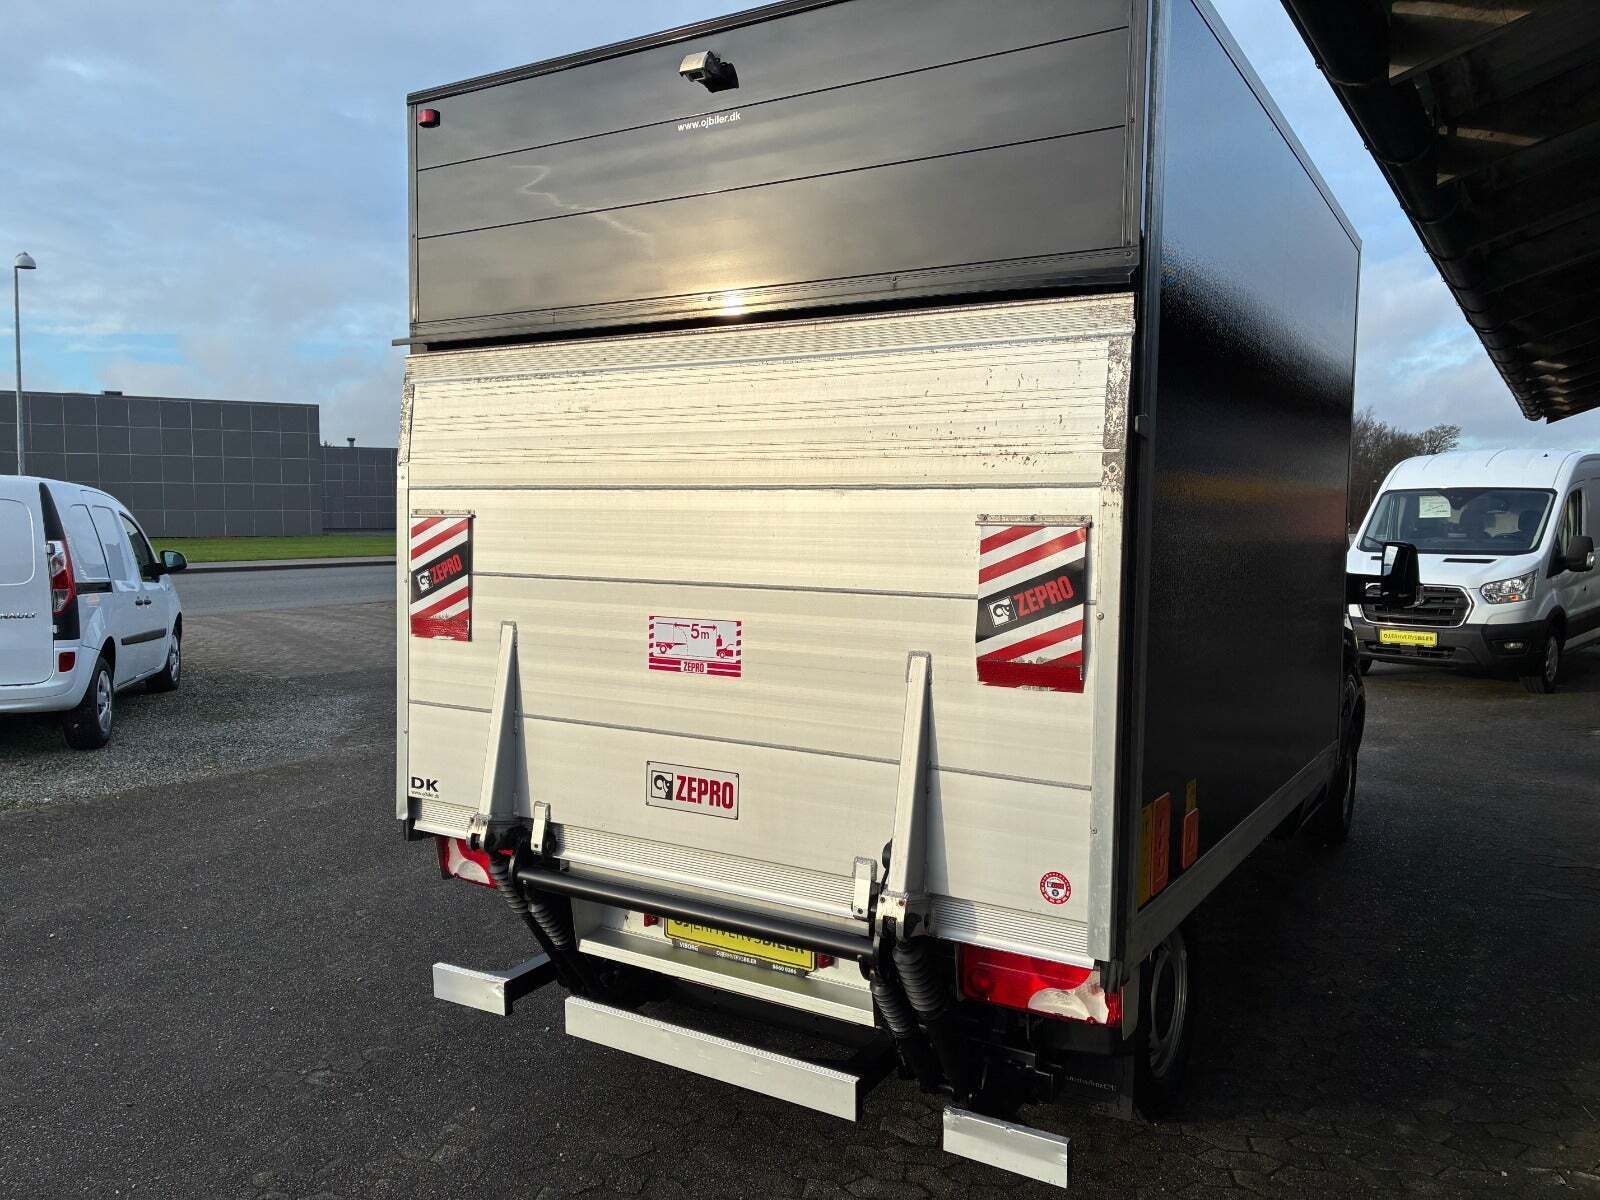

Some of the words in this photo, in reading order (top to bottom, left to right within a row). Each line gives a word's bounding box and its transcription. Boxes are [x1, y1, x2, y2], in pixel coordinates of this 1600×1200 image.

[677, 111, 741, 132] www.ojbiler.dk
[431, 554, 463, 585] ZEPRO
[1013, 575, 1074, 618] ZEPRO
[683, 661, 705, 673] ZEPRO
[411, 776, 439, 792] DK
[675, 774, 734, 810] ZEPRO
